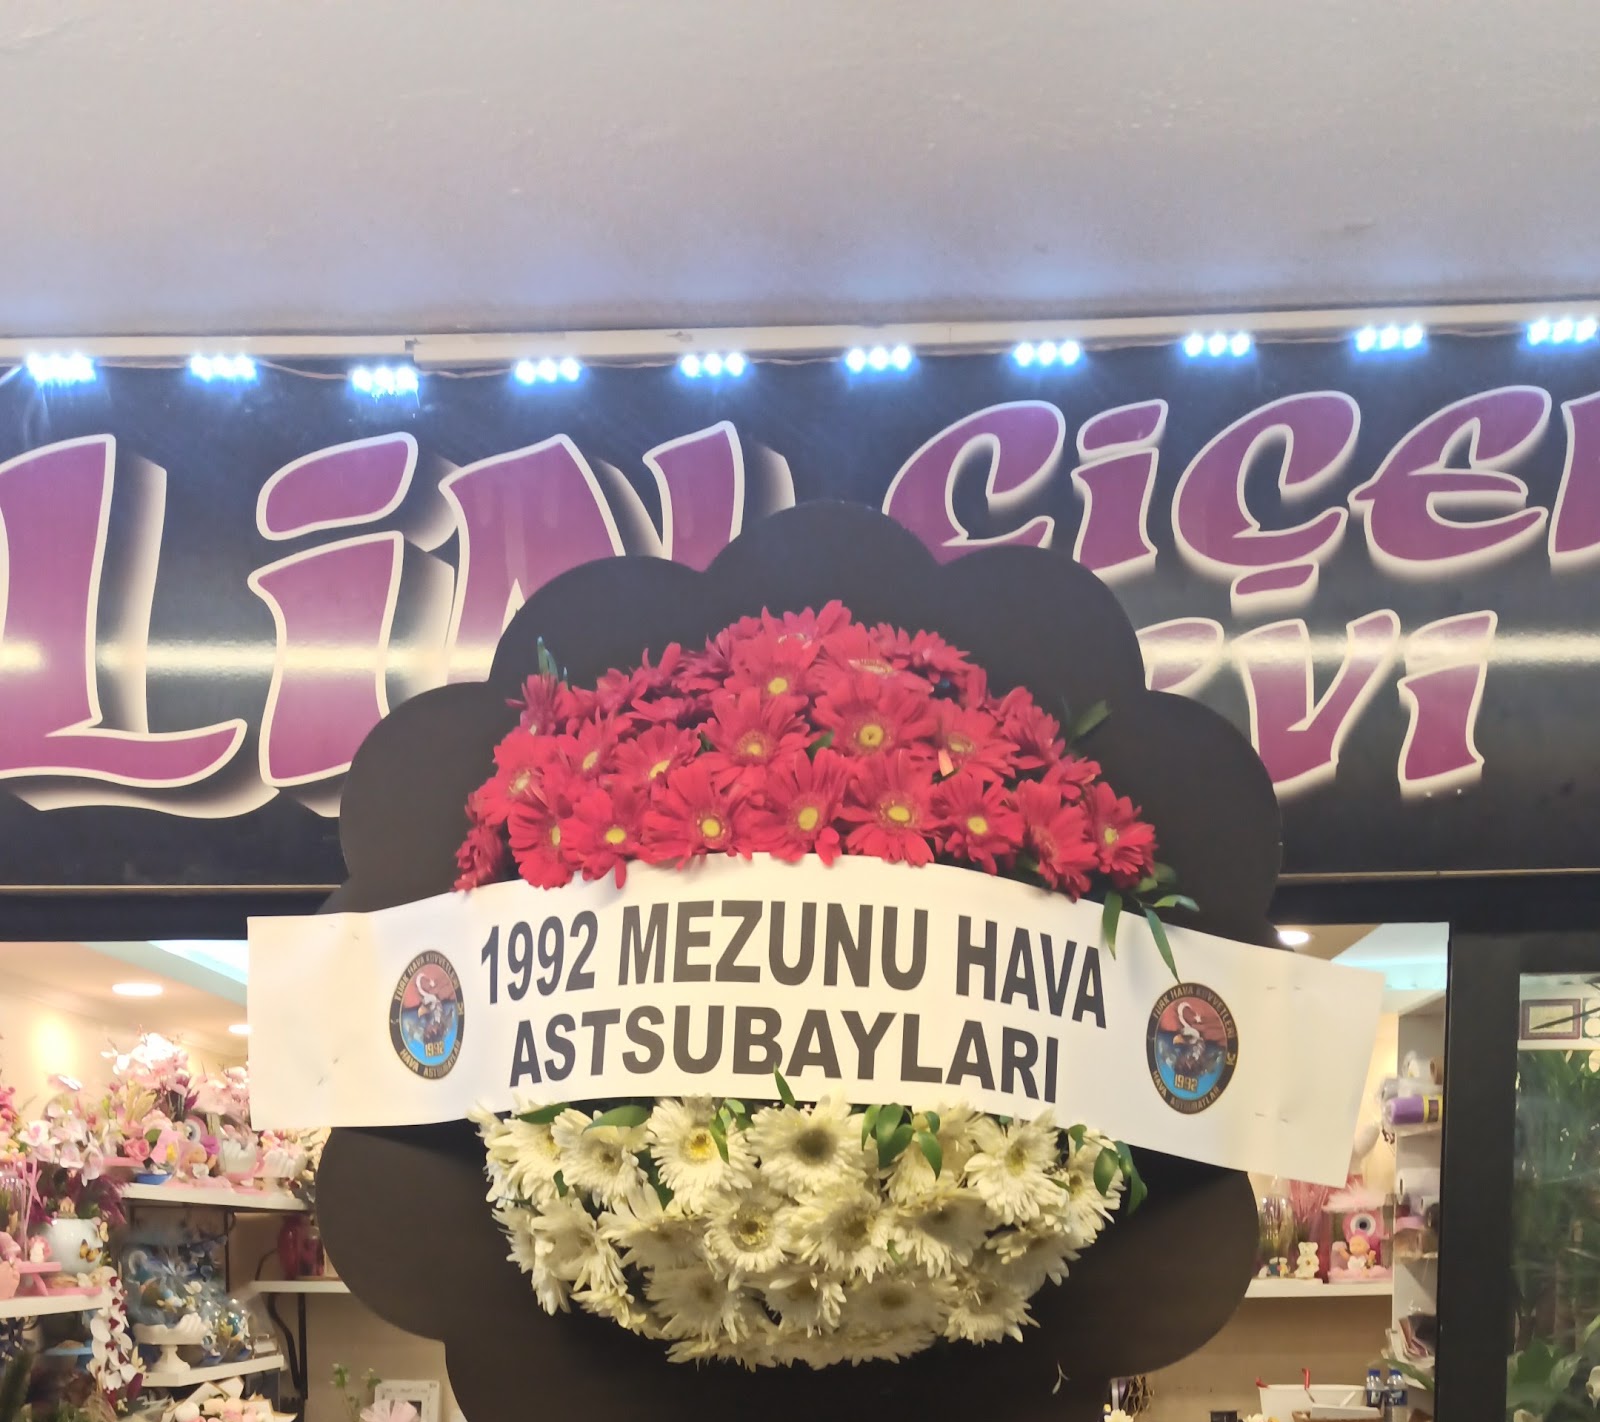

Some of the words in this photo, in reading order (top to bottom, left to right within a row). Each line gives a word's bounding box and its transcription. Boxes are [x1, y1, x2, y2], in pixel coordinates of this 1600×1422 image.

[481, 909, 599, 1004] 1992
[617, 899, 928, 992] MEZUNU
[955, 914, 1108, 1030] HAVA
[425, 1041, 445, 1057] 1992
[509, 1005, 1059, 1104] ASTSUBAYLARI
[1174, 1073, 1198, 1093] 1992
